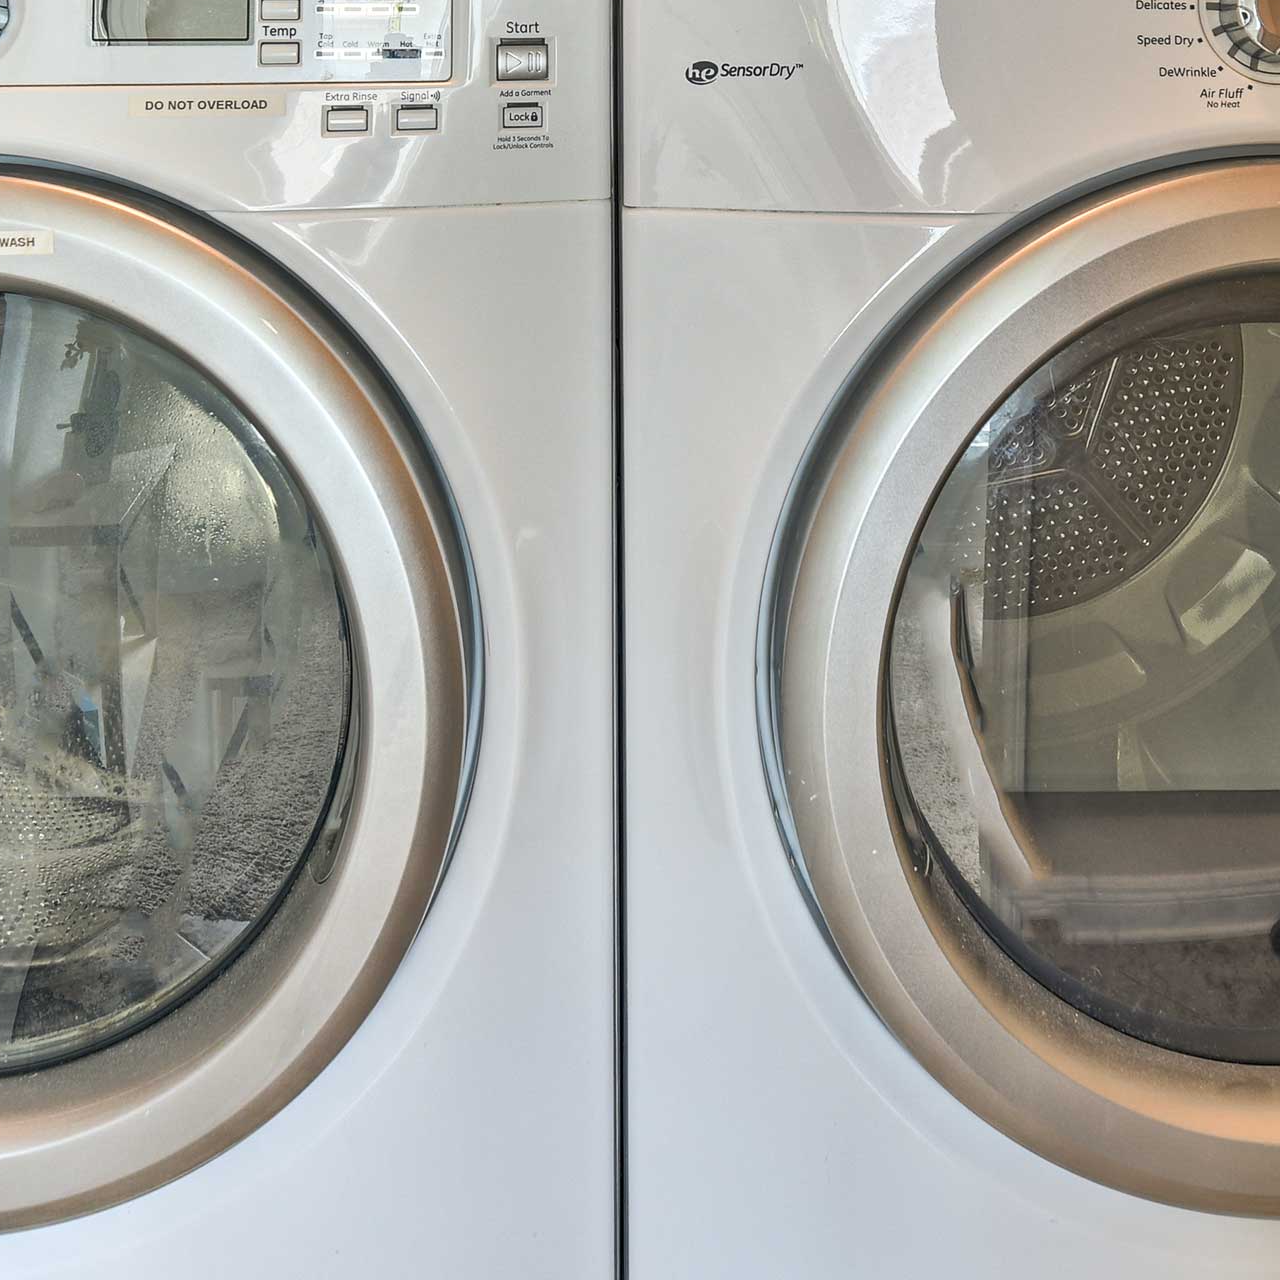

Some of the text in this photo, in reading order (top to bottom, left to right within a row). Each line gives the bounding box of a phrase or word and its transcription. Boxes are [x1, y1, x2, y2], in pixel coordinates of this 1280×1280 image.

[1136, 0, 1187, 10] Delicates
[263, 26, 297, 39] Temp
[505, 21, 540, 34] Start
[1137, 35, 1194, 47] Speed Dry
[1159, 66, 1217, 78] DeWrinkle
[325, 91, 378, 101] Extra Rinse
[400, 91, 430, 103] Signal
[500, 89, 513, 97] Add
[521, 89, 551, 97] Garment
[1199, 87, 1244, 99] Air Fluff
[145, 99, 268, 111] DO NOT OVERLOAD
[1206, 100, 1240, 108] No Heat
[509, 112, 530, 121] Lock
